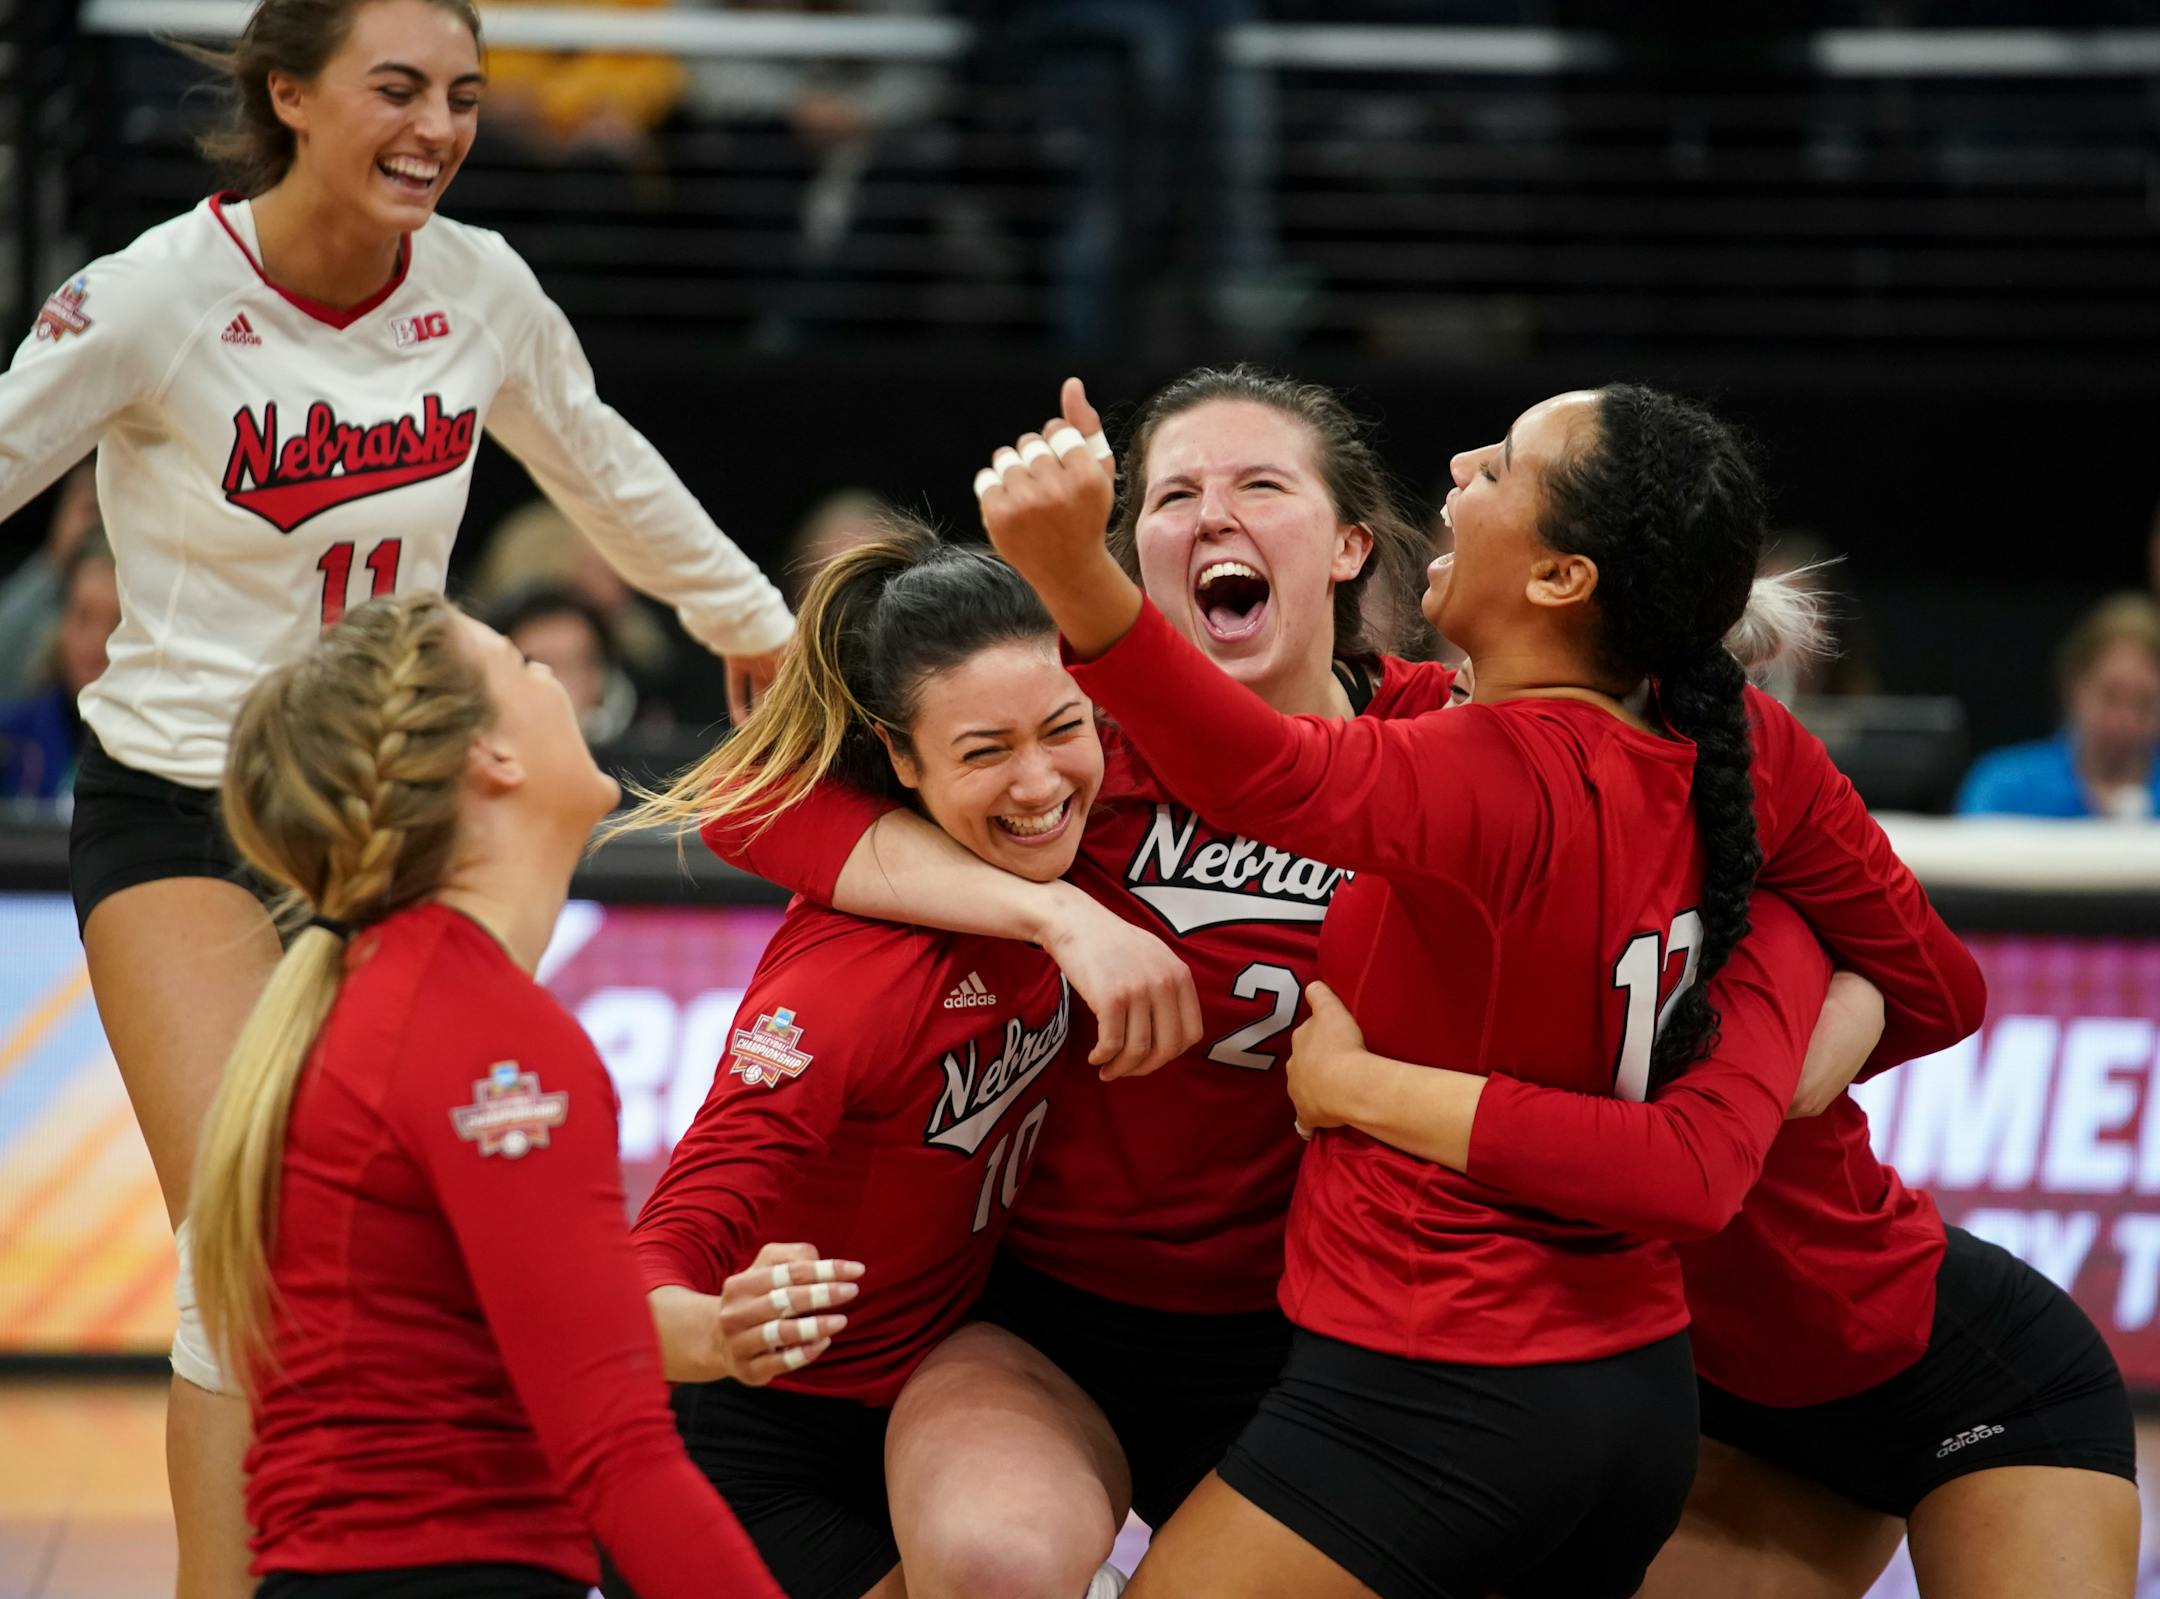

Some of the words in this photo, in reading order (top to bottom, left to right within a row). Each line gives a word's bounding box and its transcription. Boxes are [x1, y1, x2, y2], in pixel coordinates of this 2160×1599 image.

[220, 332, 262, 346] adidas
[222, 393, 477, 492] Nebraska
[317, 537, 402, 638] 11
[1126, 804, 1354, 899] Nebra
[943, 993, 997, 1009] adidas
[1207, 962, 1300, 1071] 2
[736, 1038, 803, 1069] CHAMPIONSHIP
[1936, 1424, 2005, 1459] adidas
